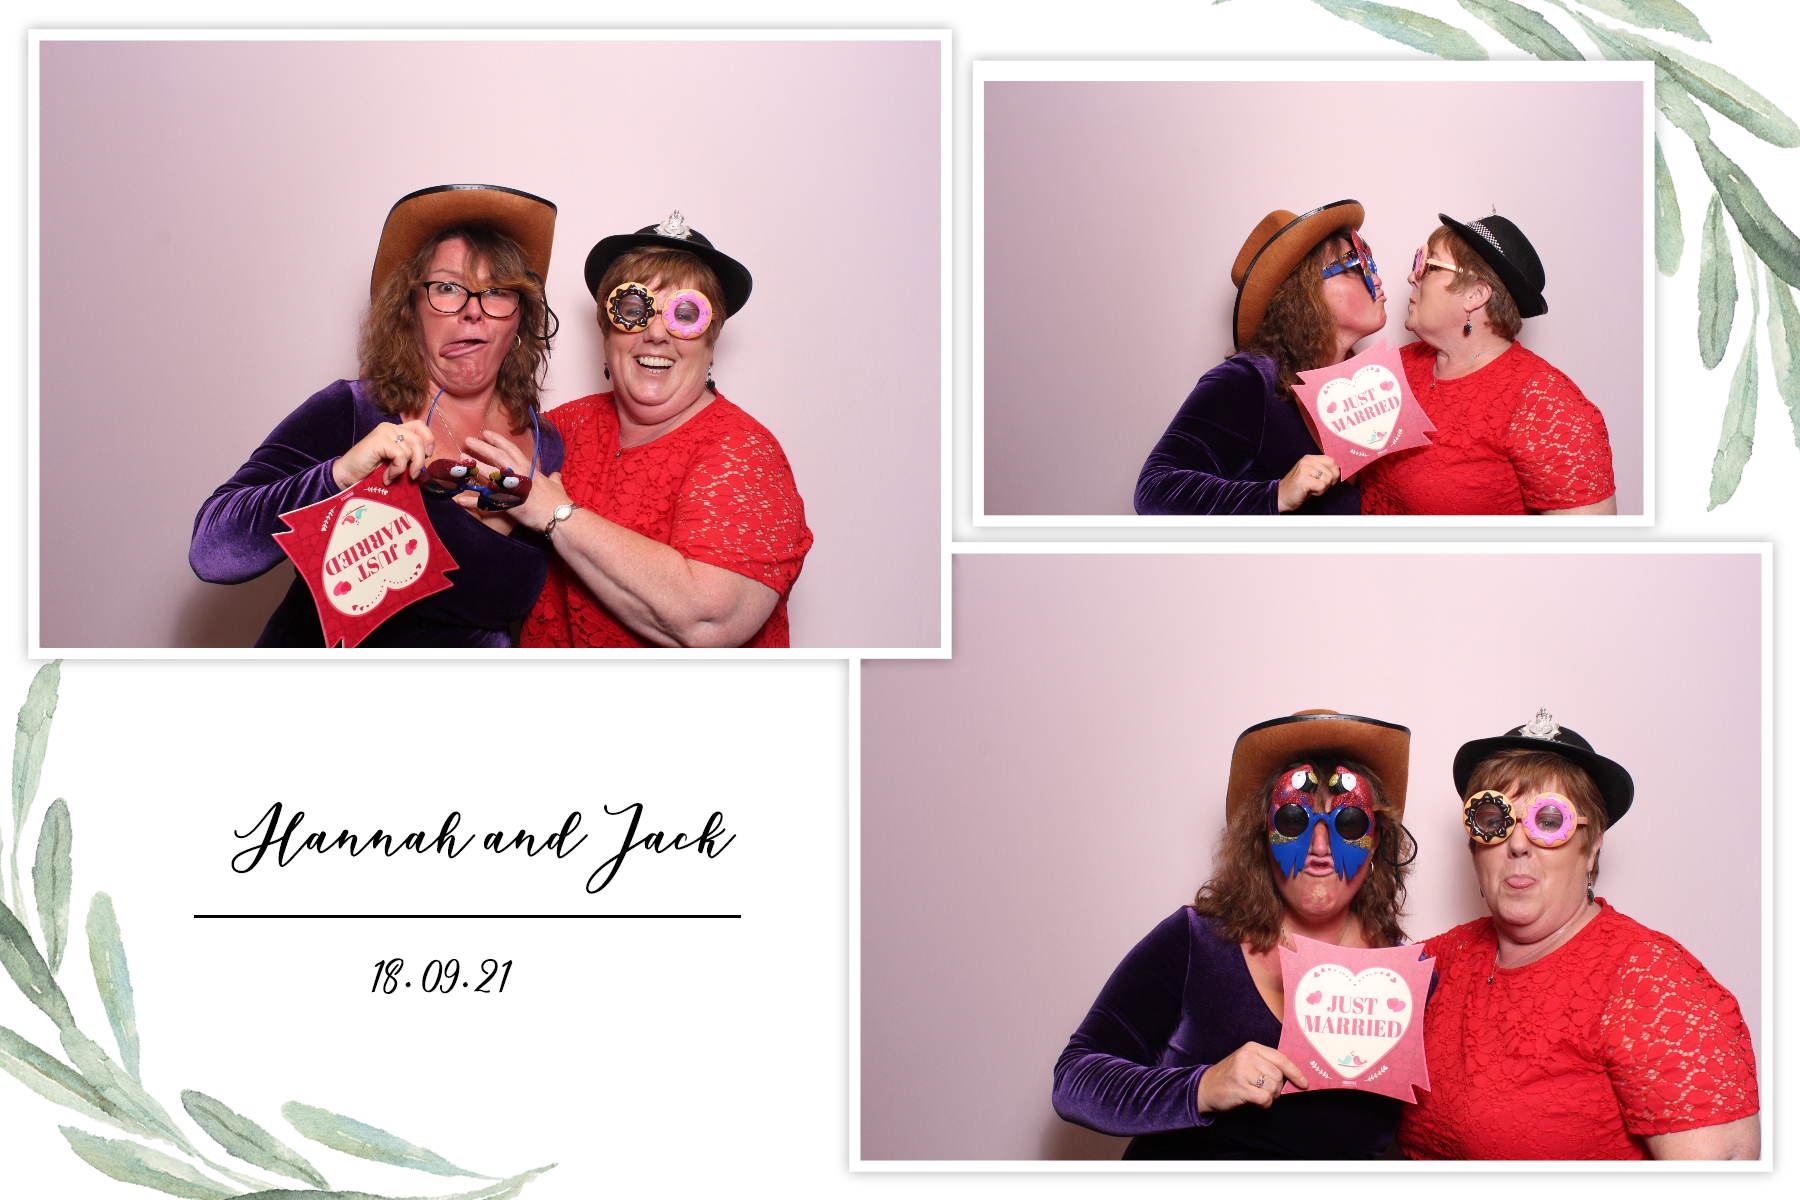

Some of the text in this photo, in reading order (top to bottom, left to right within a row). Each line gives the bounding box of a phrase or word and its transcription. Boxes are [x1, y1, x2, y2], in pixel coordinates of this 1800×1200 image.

[1332, 396, 1400, 433] MARRIED
[1343, 388, 1376, 413] JUST
[326, 514, 412, 576] MARRIED
[358, 543, 398, 582] JUST
[1327, 995, 1378, 1015] JUST
[1304, 1015, 1402, 1038] MARRIED
